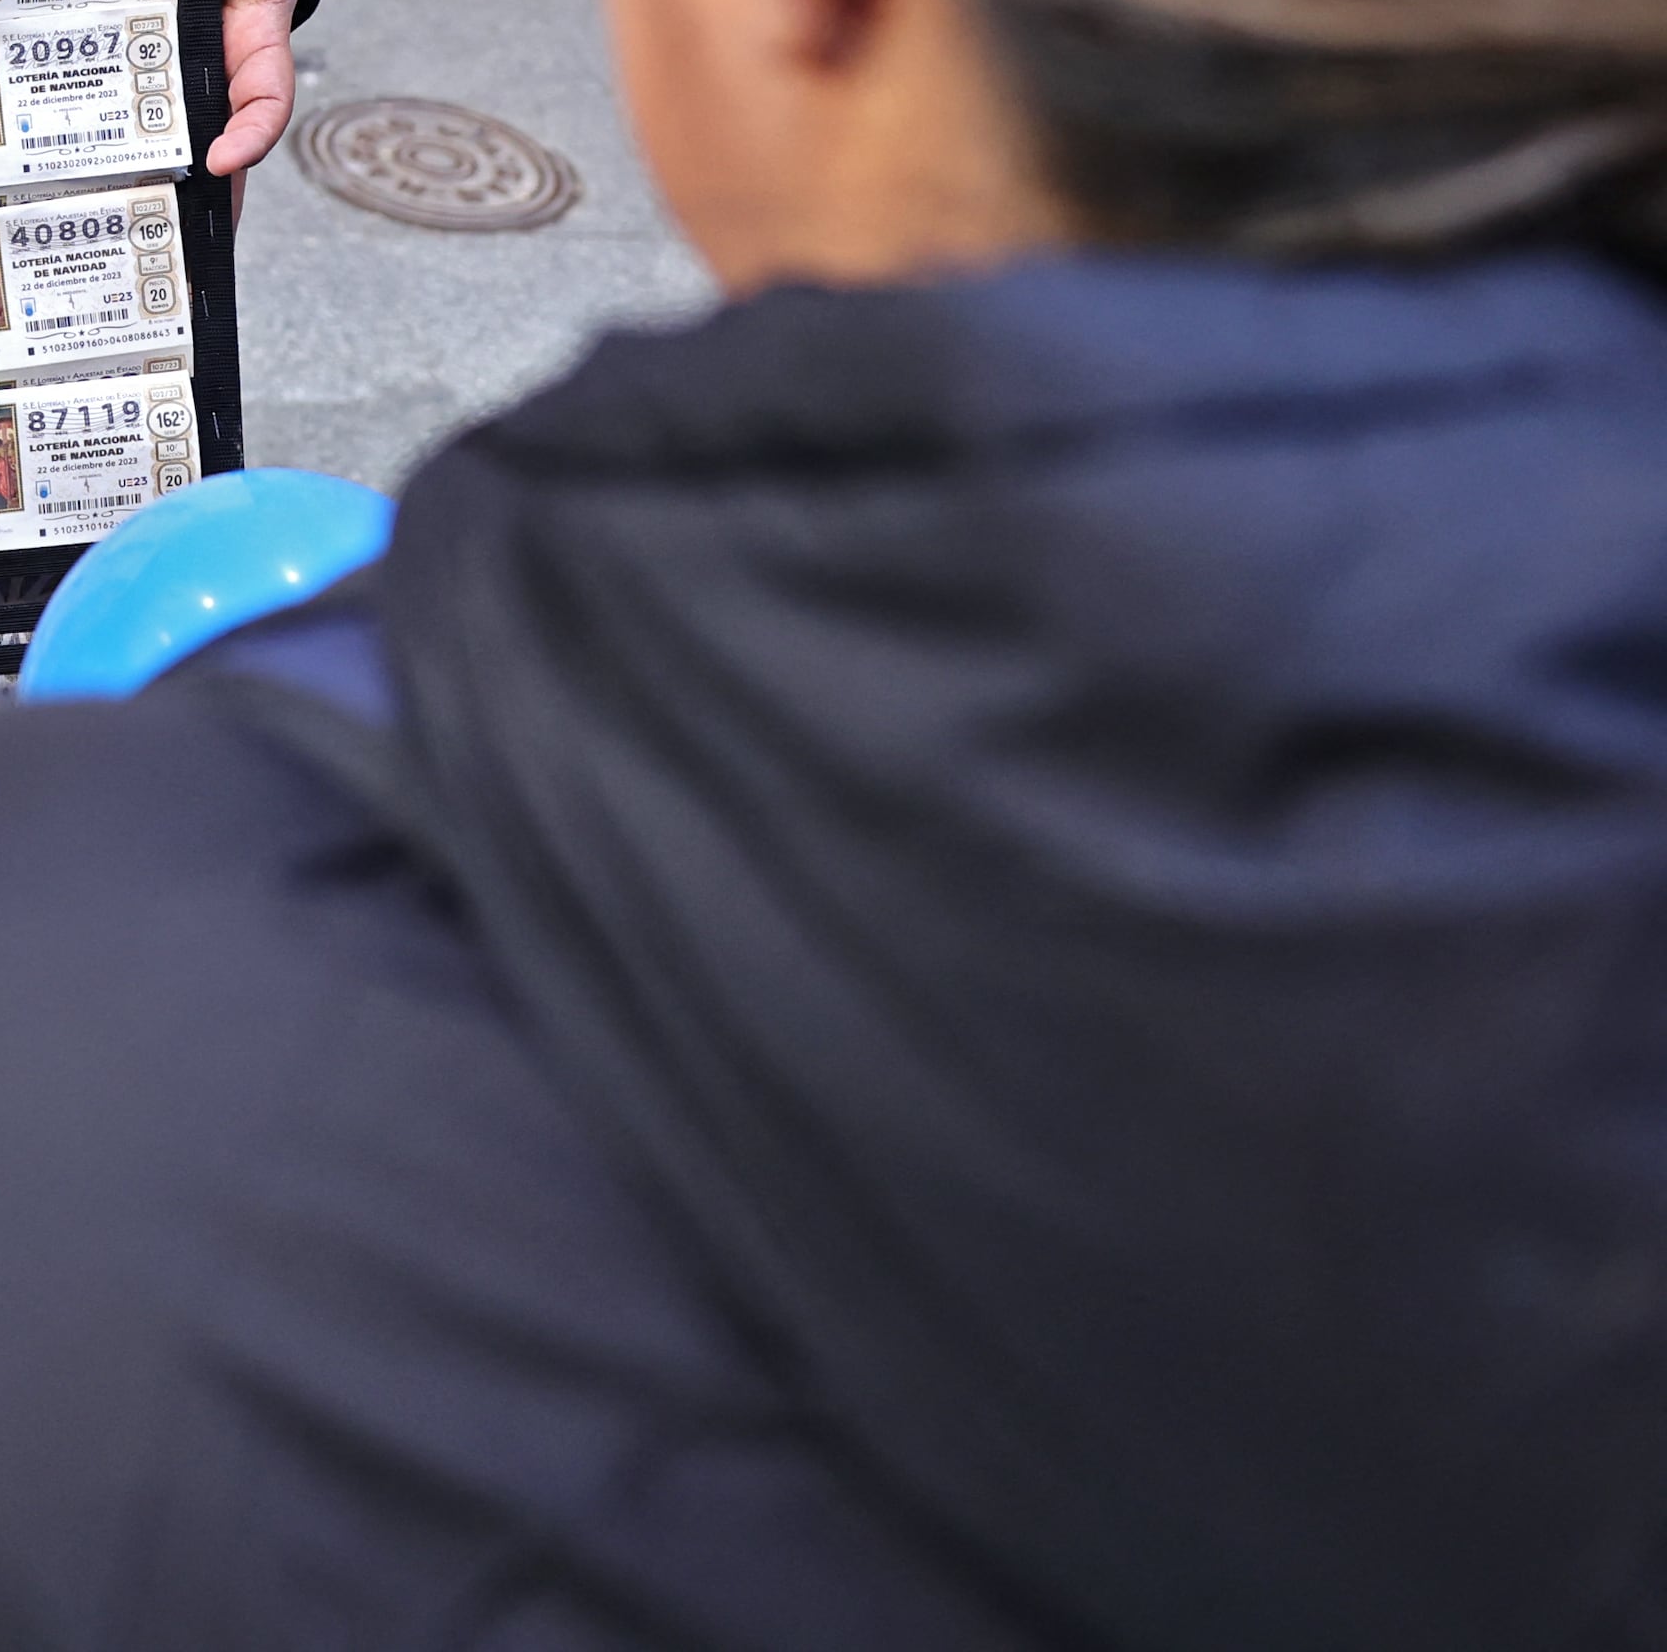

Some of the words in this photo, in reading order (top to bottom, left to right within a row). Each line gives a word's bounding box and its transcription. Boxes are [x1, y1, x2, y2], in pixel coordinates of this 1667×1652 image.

[9, 31, 120, 65] 20967
[9, 69, 59, 84] LOTERÍA
[63, 65, 122, 79] NACIONAL
[31, 84, 46, 93] DE
[50, 79, 103, 92] NAVIDAD
[147, 107, 163, 121] 20
[12, 216, 124, 247] 40808
[12, 253, 62, 268] LOTERÍA
[66, 247, 125, 262] NACIONAL
[34, 268, 49, 277] DE
[53, 261, 106, 275] NAVIDAD
[29, 402, 140, 432] 87119
[29, 437, 79, 451] LOTERÍA
[83, 433, 142, 446] NACIONAL
[50, 452, 65, 461] DE
[69, 446, 123, 459] NAVIDAD
